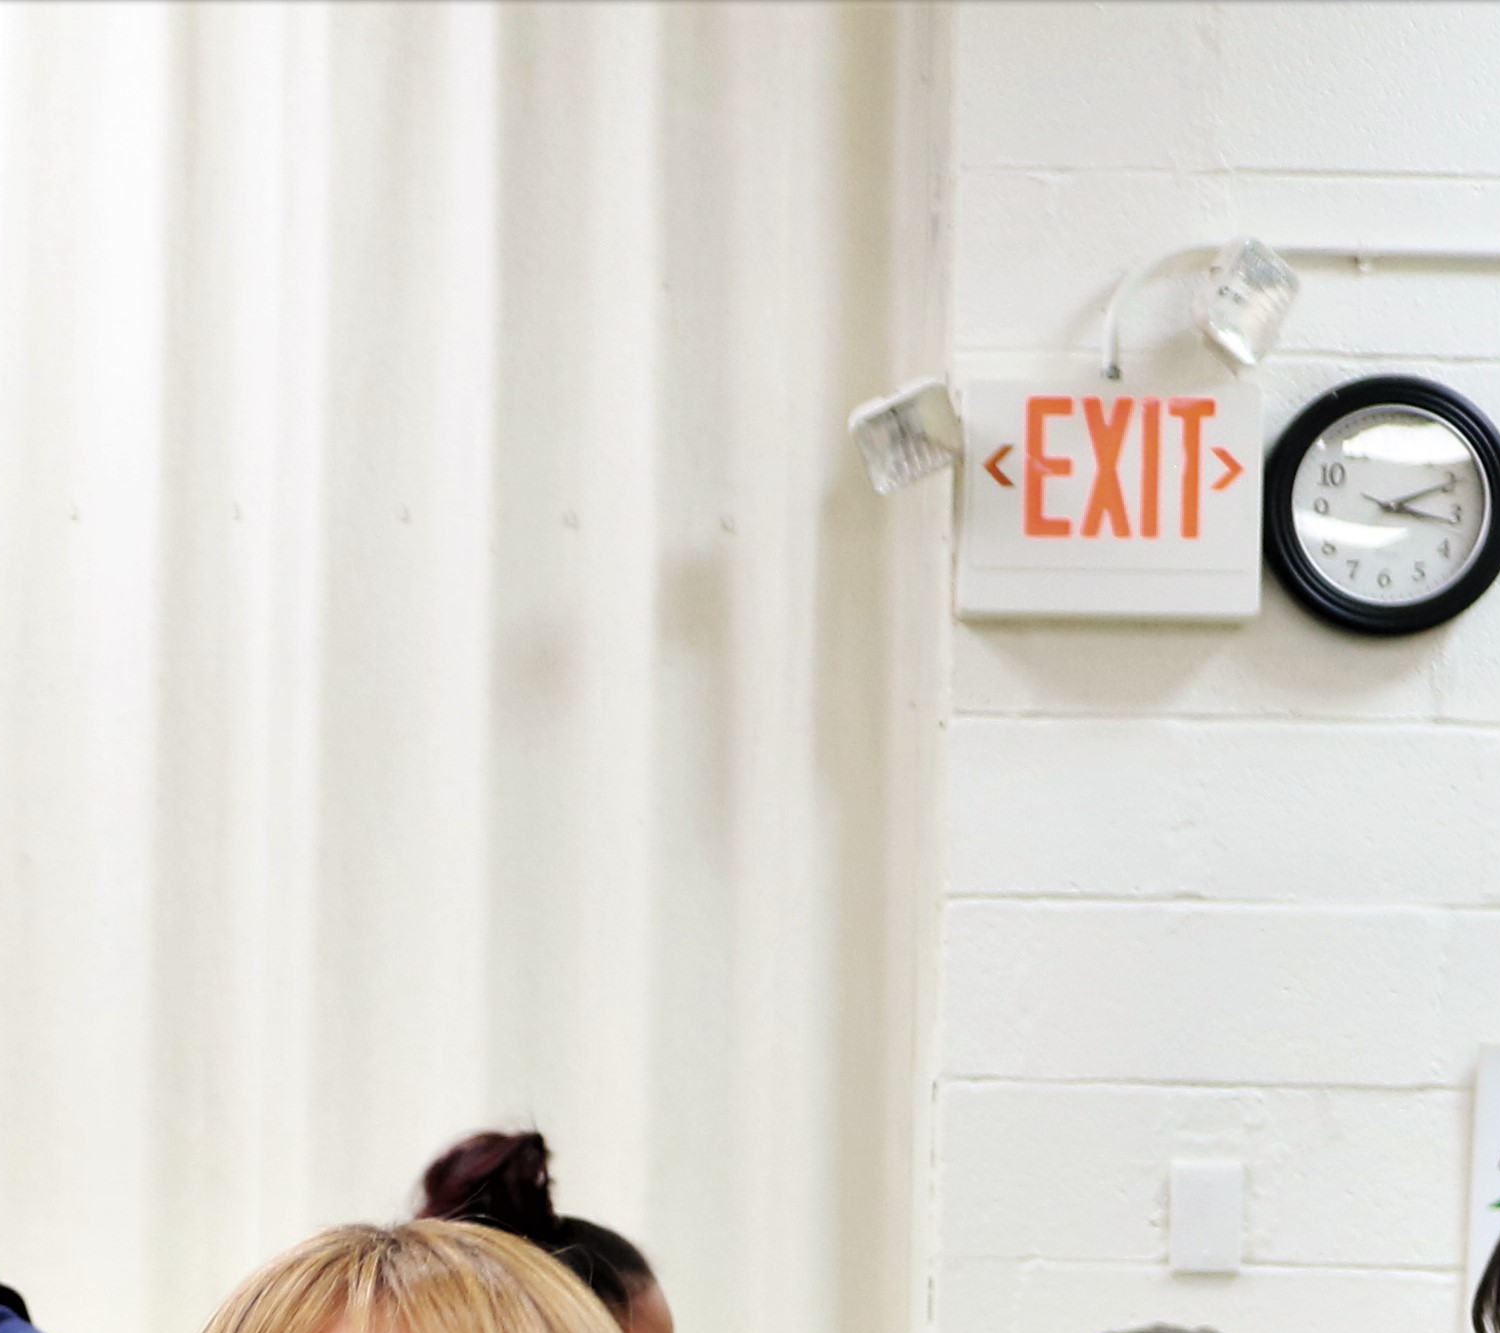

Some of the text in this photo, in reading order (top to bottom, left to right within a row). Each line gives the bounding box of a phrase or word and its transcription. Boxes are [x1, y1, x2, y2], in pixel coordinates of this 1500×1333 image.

[1023, 395, 1217, 540] EXIT
[1318, 463, 1346, 487] 10
[1437, 538, 1453, 559] 4
[1345, 559, 1363, 580] 7
[1376, 570, 1392, 589] 6
[1412, 561, 1427, 580] 5
